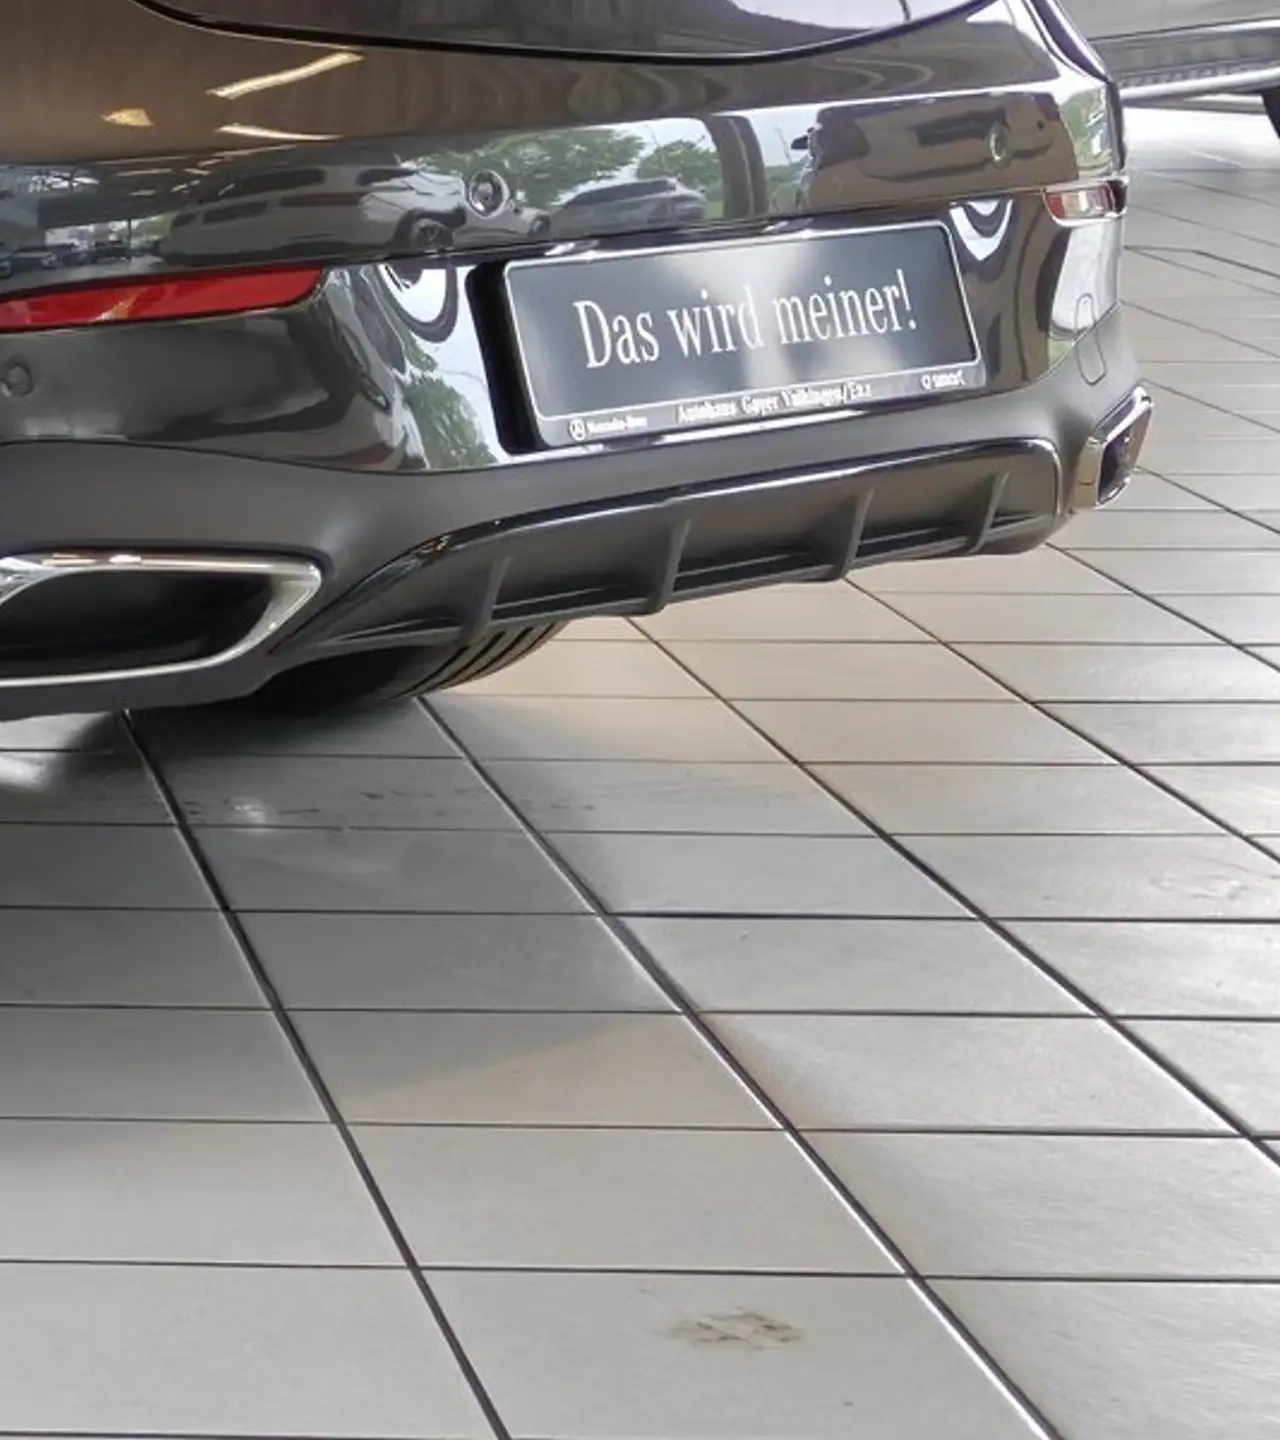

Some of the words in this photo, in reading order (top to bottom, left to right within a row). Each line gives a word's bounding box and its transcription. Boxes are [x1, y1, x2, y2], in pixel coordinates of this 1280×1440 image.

[573, 299, 660, 369] Das
[666, 285, 764, 358] wird
[772, 268, 918, 345] meiner!
